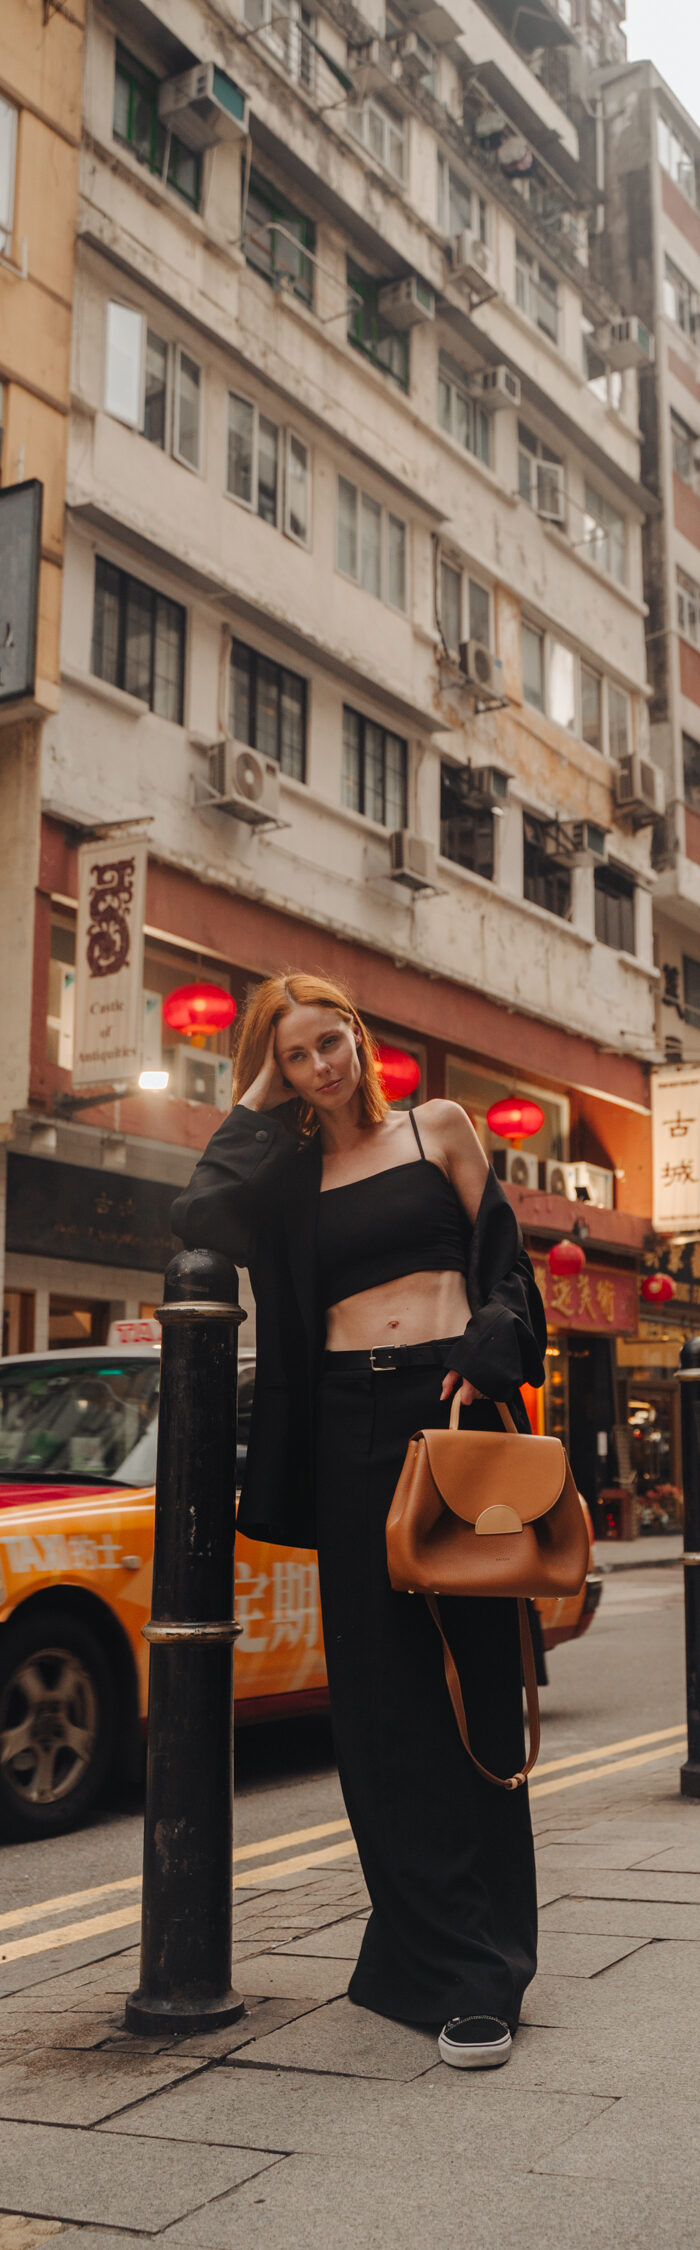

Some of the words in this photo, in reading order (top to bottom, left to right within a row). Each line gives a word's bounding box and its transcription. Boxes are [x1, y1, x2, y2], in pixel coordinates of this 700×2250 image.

[89, 999, 124, 1015] Castle
[99, 1026, 111, 1039] of
[79, 1046, 137, 1064] Antiquities
[661, 1109, 699, 1188] 古城
[116, 1322, 162, 1344] TA
